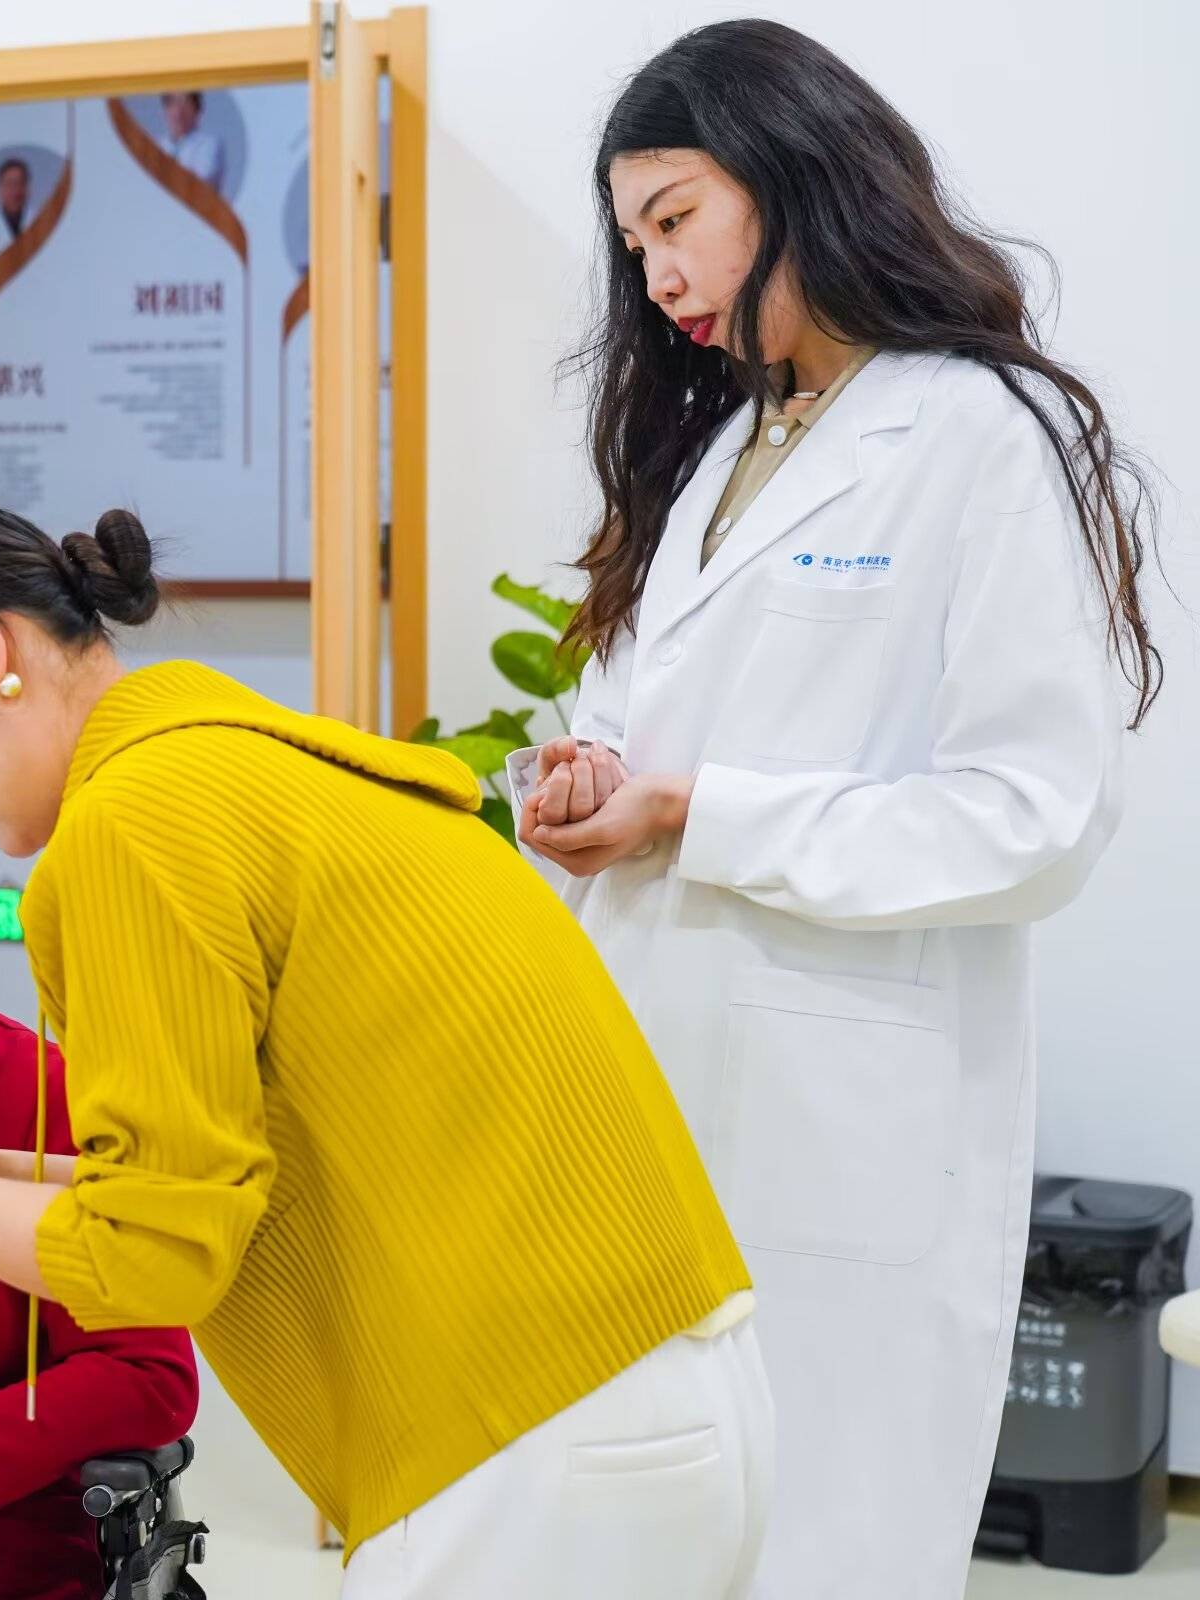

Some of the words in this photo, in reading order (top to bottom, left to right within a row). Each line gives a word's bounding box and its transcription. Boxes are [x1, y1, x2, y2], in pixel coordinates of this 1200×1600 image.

[822, 556, 891, 568] 南京华眼科医院
